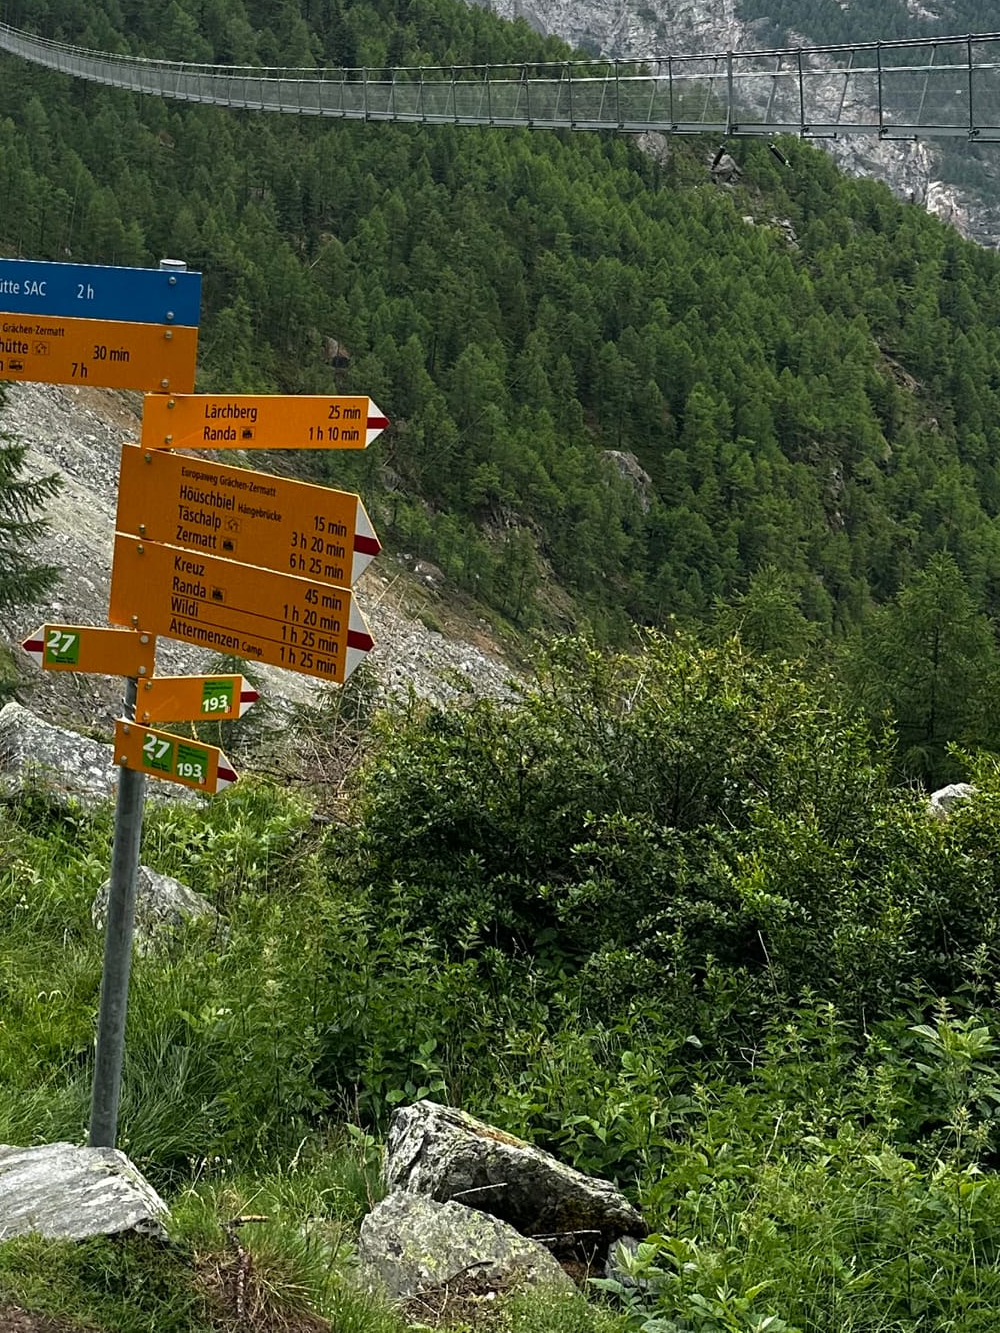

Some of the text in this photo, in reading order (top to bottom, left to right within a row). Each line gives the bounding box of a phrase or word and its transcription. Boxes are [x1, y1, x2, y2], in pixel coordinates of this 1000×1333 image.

[24, 281, 47, 296] SAC
[77, 284, 84, 298] 2
[87, 285, 94, 299] h
[3, 323, 65, 336] Grächen-Zermatt
[93, 346, 107, 360] 30
[109, 346, 129, 362] min
[71, 363, 78, 377] 7
[80, 363, 87, 378] h
[205, 404, 361, 422] Lärchberg 25 min
[204, 427, 359, 440] Randa 1 h 10 min
[182, 467, 276, 497] Europaweg Grächen-Zermatt
[180, 485, 347, 537] Höüschbiel Hängebrücke 15 min
[178, 505, 345, 558] Täschalp 3 h 20 min
[176, 526, 343, 579] Zermatt 6 h 25 min
[174, 556, 342, 610] Kreuz 45 min
[173, 577, 340, 632] Randa 1 h 20 min
[171, 597, 338, 653] Wildi 1 h 25 min
[47, 631, 75, 653] 27
[169, 618, 337, 675] Attermenzen Camp. 1 h 25 min
[203, 695, 228, 712] 193
[143, 734, 170, 759] 27
[177, 762, 202, 777] 193
